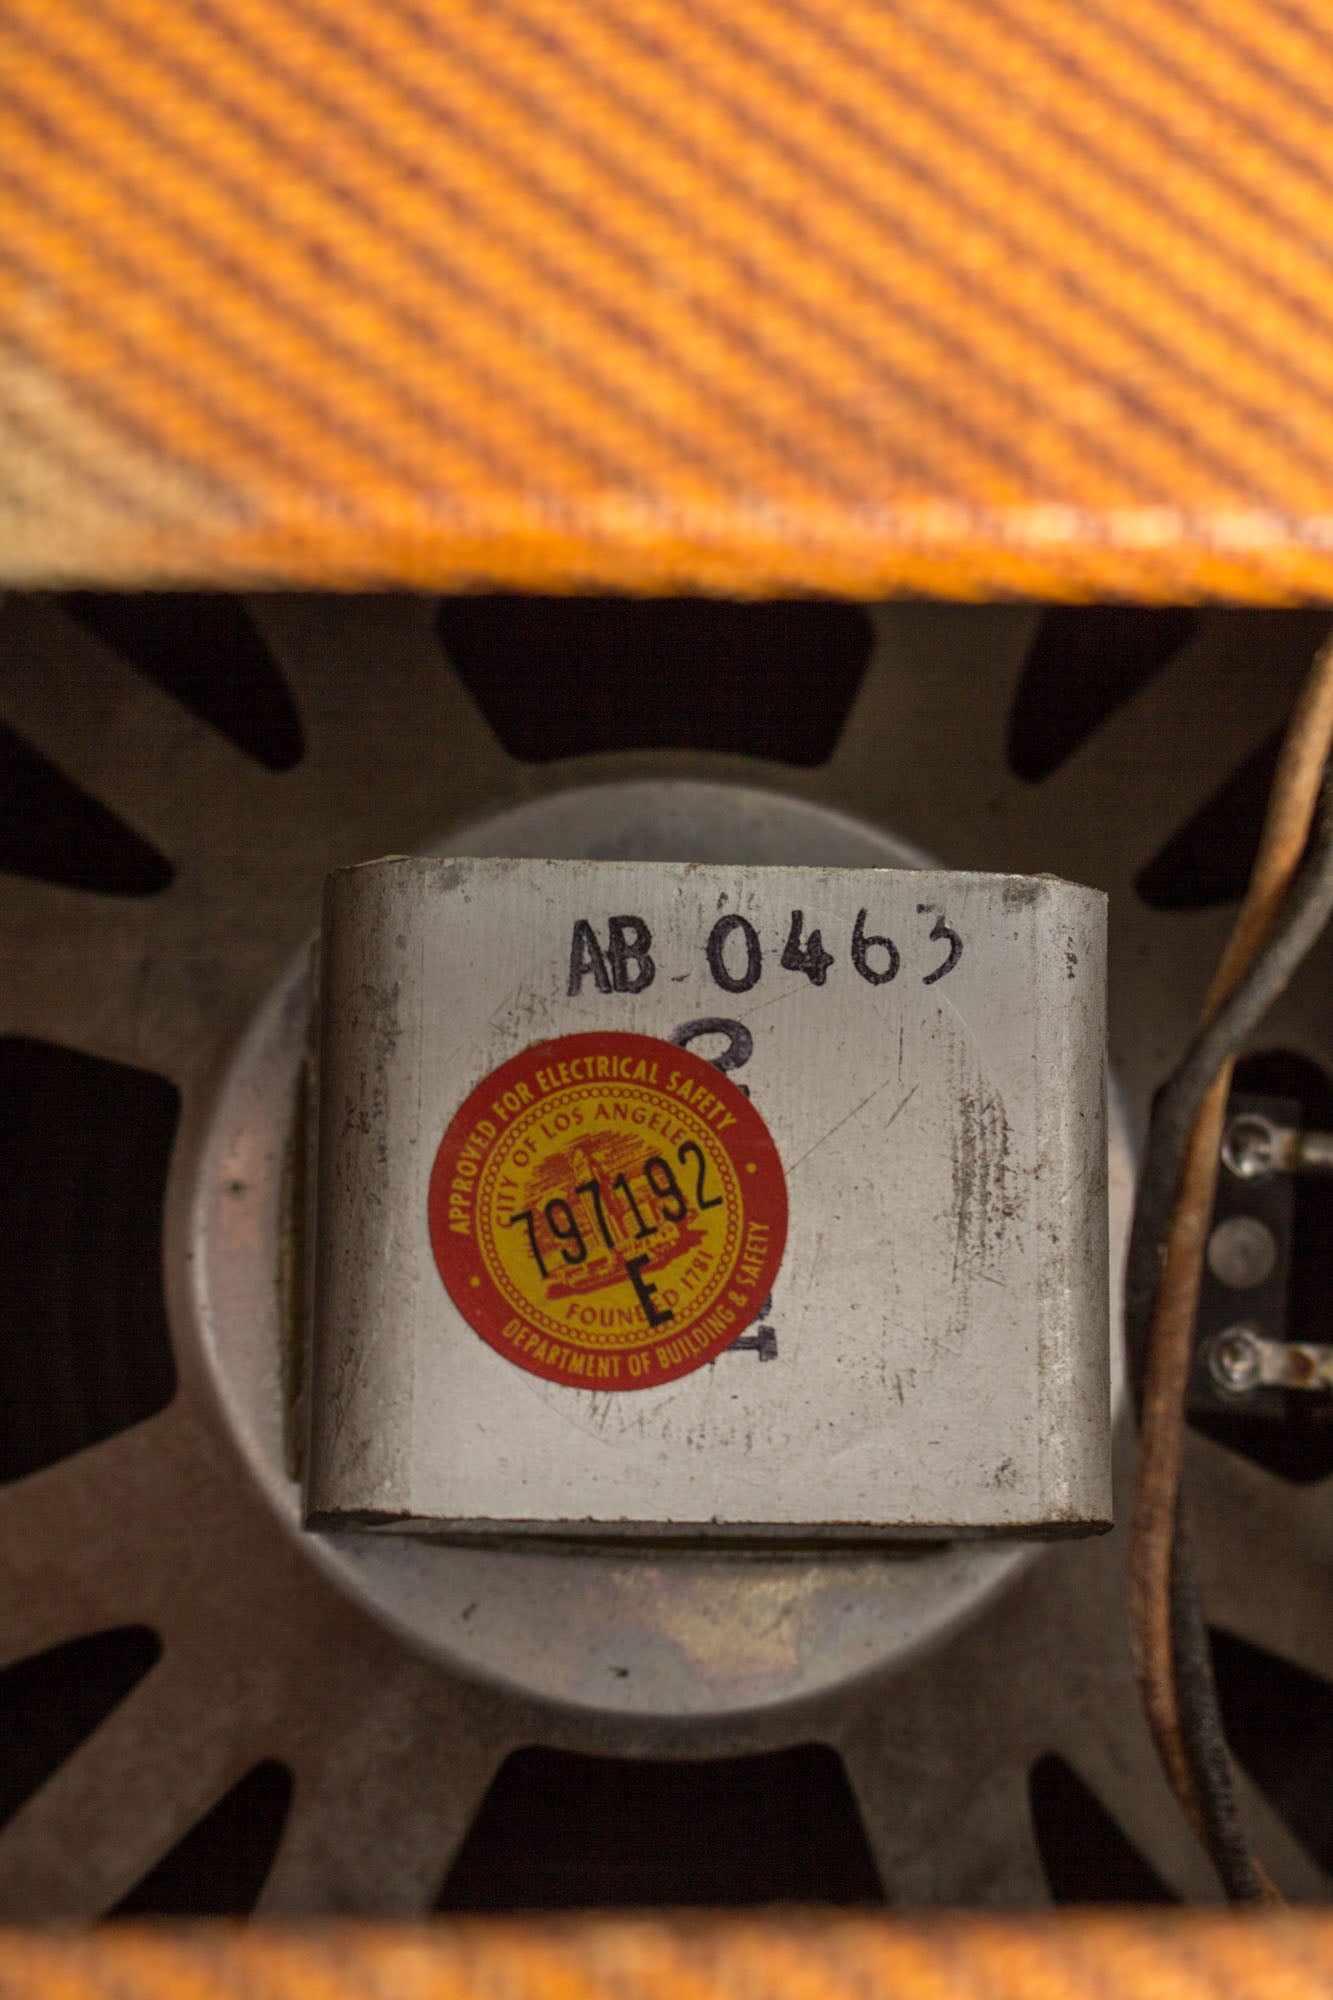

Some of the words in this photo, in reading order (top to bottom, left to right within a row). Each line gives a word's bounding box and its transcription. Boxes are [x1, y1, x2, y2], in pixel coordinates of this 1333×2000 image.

[567, 914, 655, 996] AB
[706, 904, 964, 993] 0463
[447, 1118, 498, 1236] APPROVED
[491, 1081, 535, 1122] FOR
[536, 1055, 659, 1093] ELECTRICAL
[664, 1071, 738, 1131] SAFETY
[495, 1175, 519, 1230] CITY
[512, 1135, 538, 1168] OF
[540, 1107, 584, 1141] LOS
[594, 1102, 694, 1151] ANGELE
[510, 1140, 724, 1278] 797192
[680, 1249, 714, 1291] 1781
[736, 1220, 771, 1287] SAFETY
[625, 1252, 674, 1328] E
[731, 1290, 749, 1309] &
[502, 1318, 620, 1378] DEPARTMENT
[627, 1350, 652, 1378] OF
[657, 1307, 738, 1371] BUILDING
